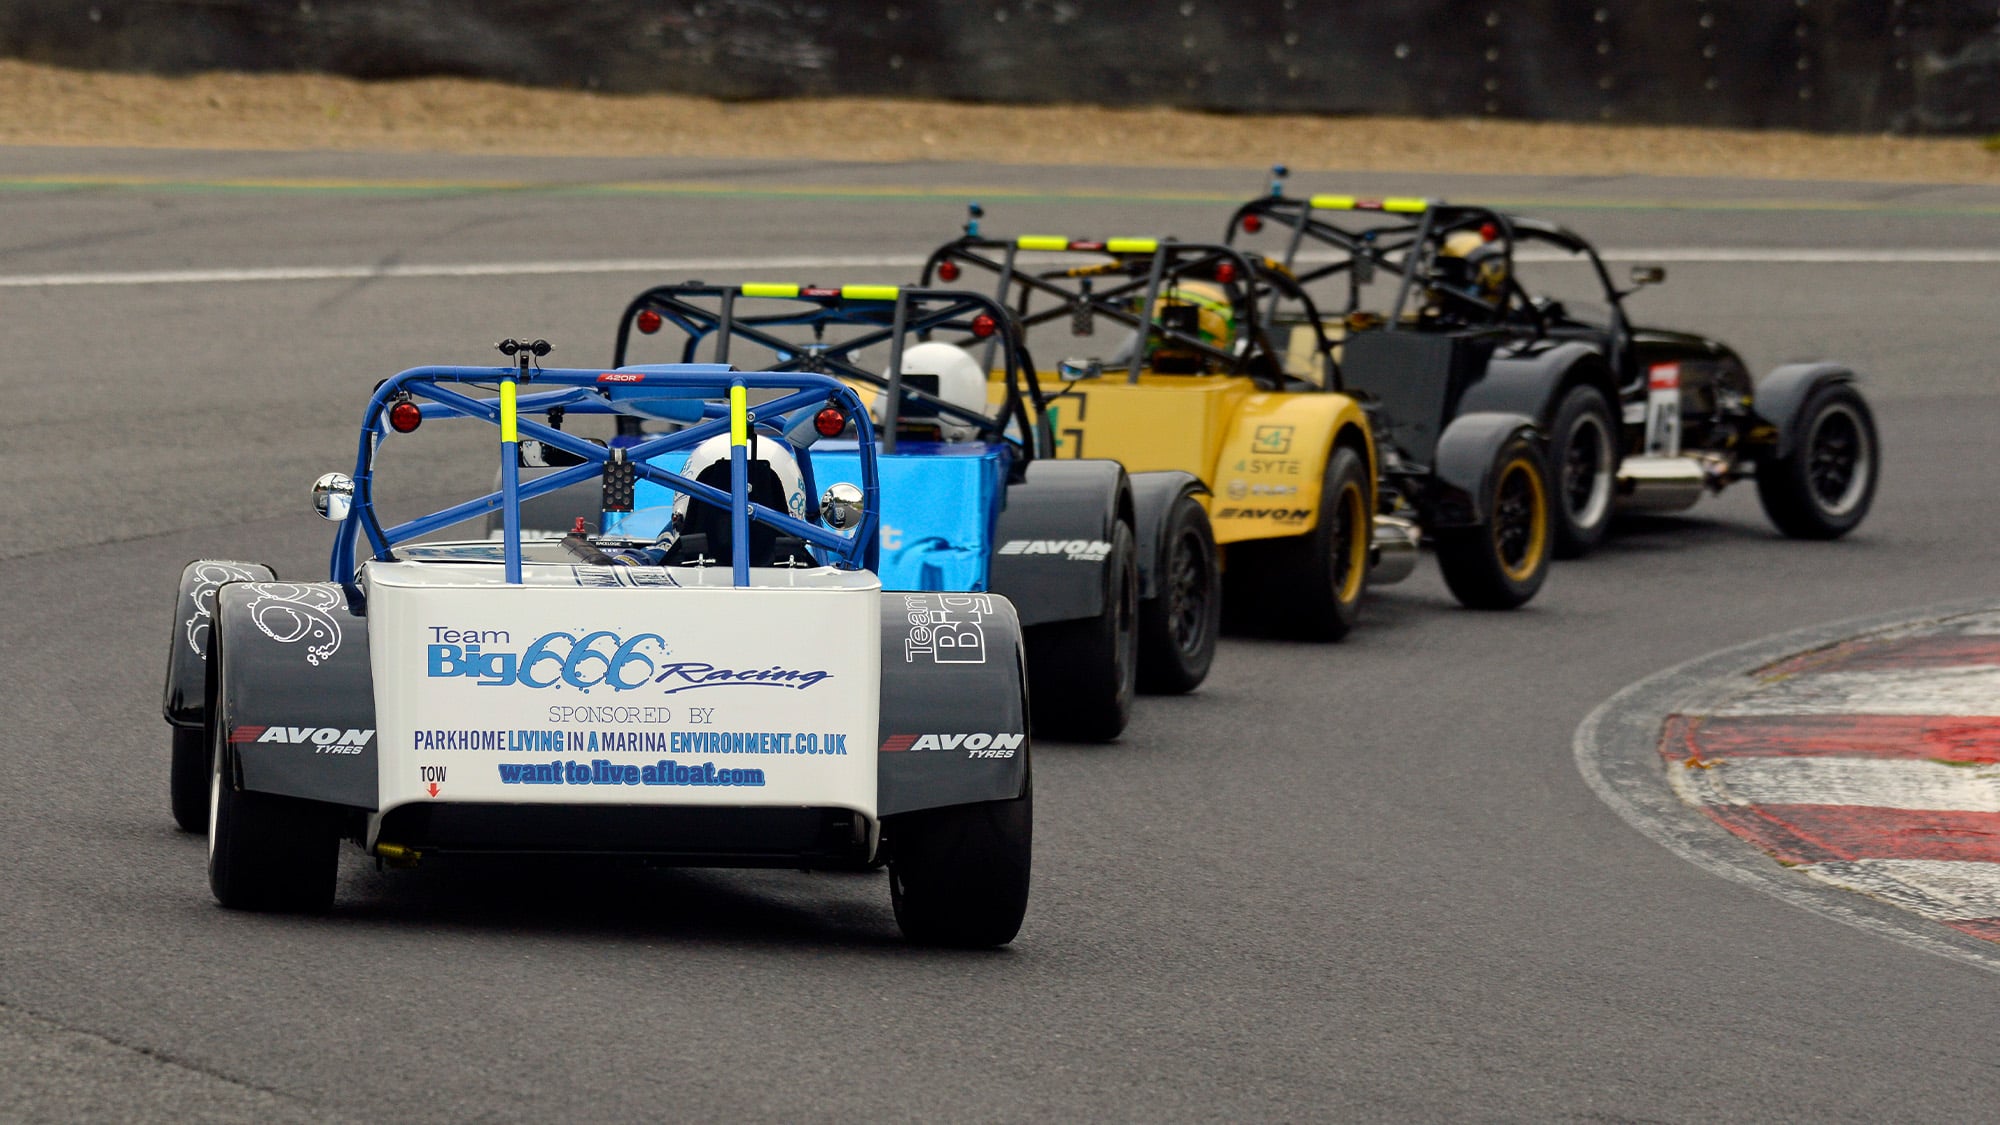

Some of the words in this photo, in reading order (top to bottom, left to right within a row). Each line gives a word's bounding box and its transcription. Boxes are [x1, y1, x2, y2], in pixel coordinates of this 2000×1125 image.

[604, 374, 637, 382] 420R
[1023, 540, 1112, 555] AVON
[428, 626, 510, 644] Team
[905, 594, 933, 662] Team
[655, 662, 834, 692] Racing
[548, 705, 671, 723] SPONSORED
[689, 707, 715, 724] BY
[257, 726, 376, 745] AVON
[601, 731, 667, 752] MARINA
[911, 733, 1025, 750] AVON
[315, 745, 364, 755] TYRES
[968, 750, 1015, 758] TYRES
[420, 766, 447, 782] TOW
[498, 760, 564, 784] want
[591, 759, 641, 785] live
[641, 760, 765, 786] afloat.com
